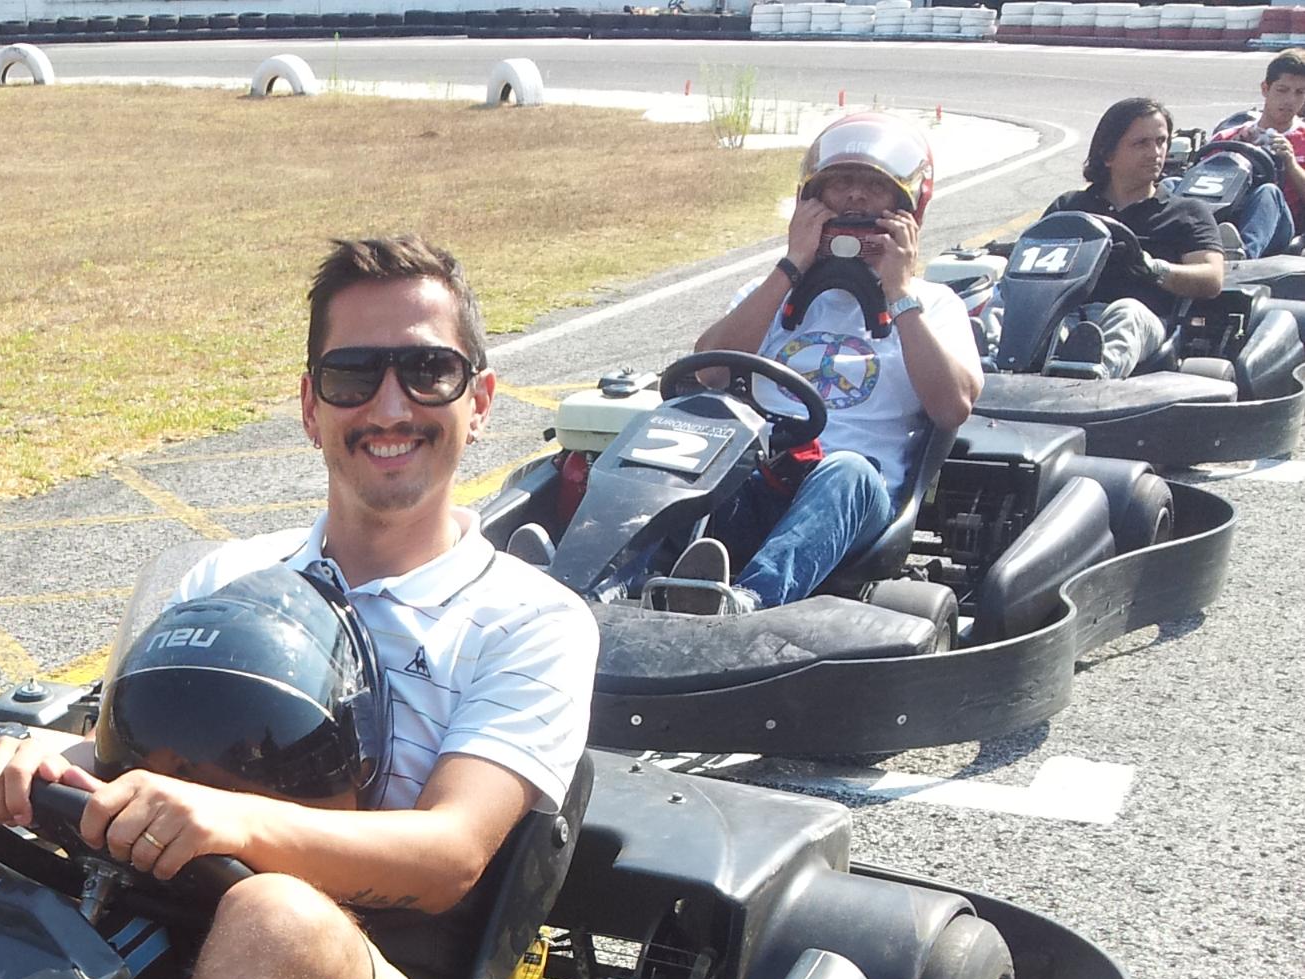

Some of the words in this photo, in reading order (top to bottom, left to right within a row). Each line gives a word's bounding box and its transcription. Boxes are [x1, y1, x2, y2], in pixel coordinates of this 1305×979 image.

[1188, 175, 1225, 195] 5
[1019, 246, 1070, 272] 14
[630, 428, 709, 470] 2
[145, 628, 221, 653] neu
